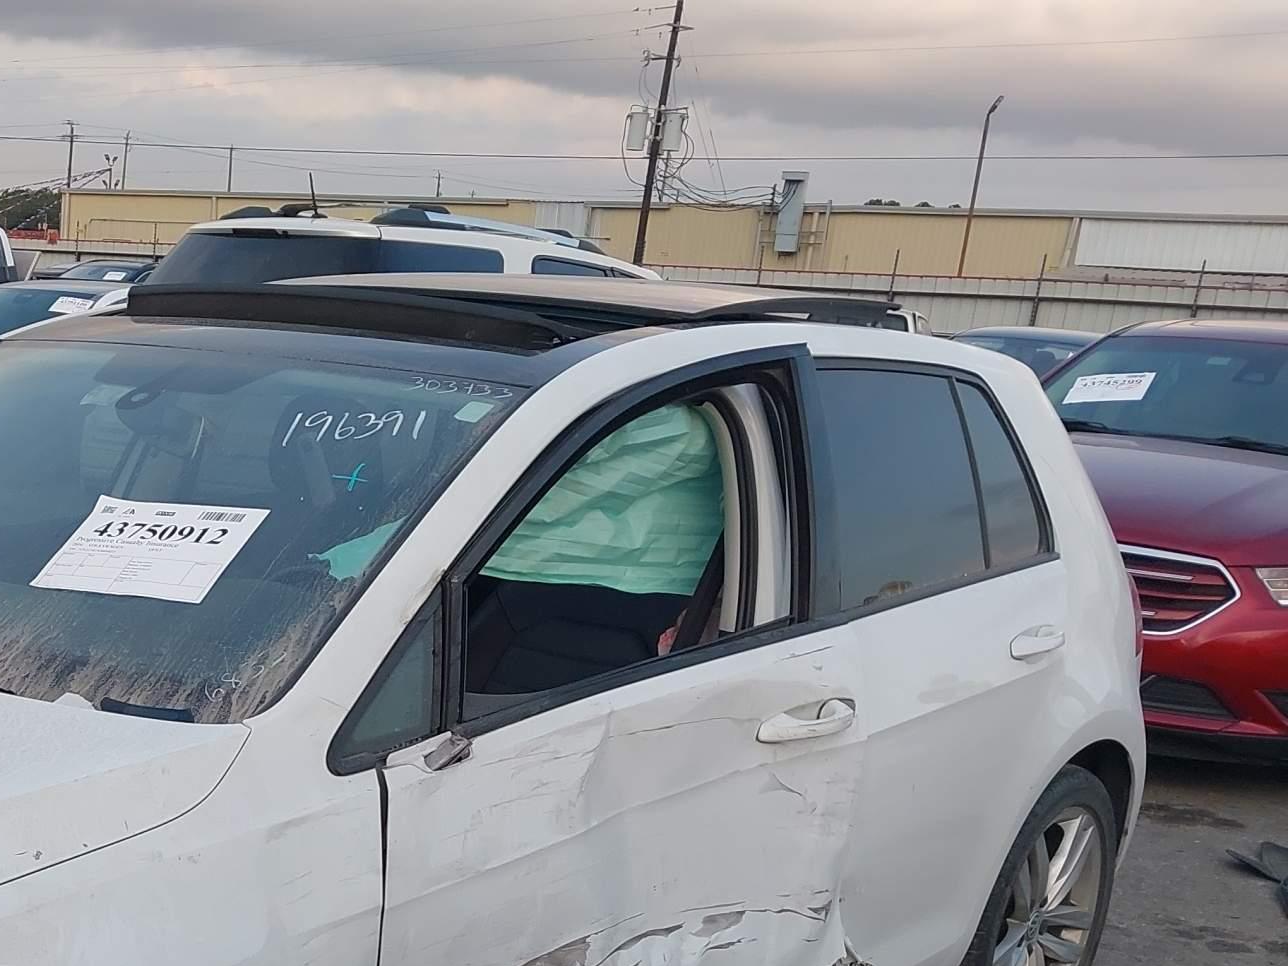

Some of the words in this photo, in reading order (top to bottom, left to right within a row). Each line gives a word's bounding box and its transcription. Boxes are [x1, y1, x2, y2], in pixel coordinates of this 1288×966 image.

[410, 376, 513, 399] 303733
[281, 410, 427, 447] 196391
[93, 520, 229, 545] 43750912
